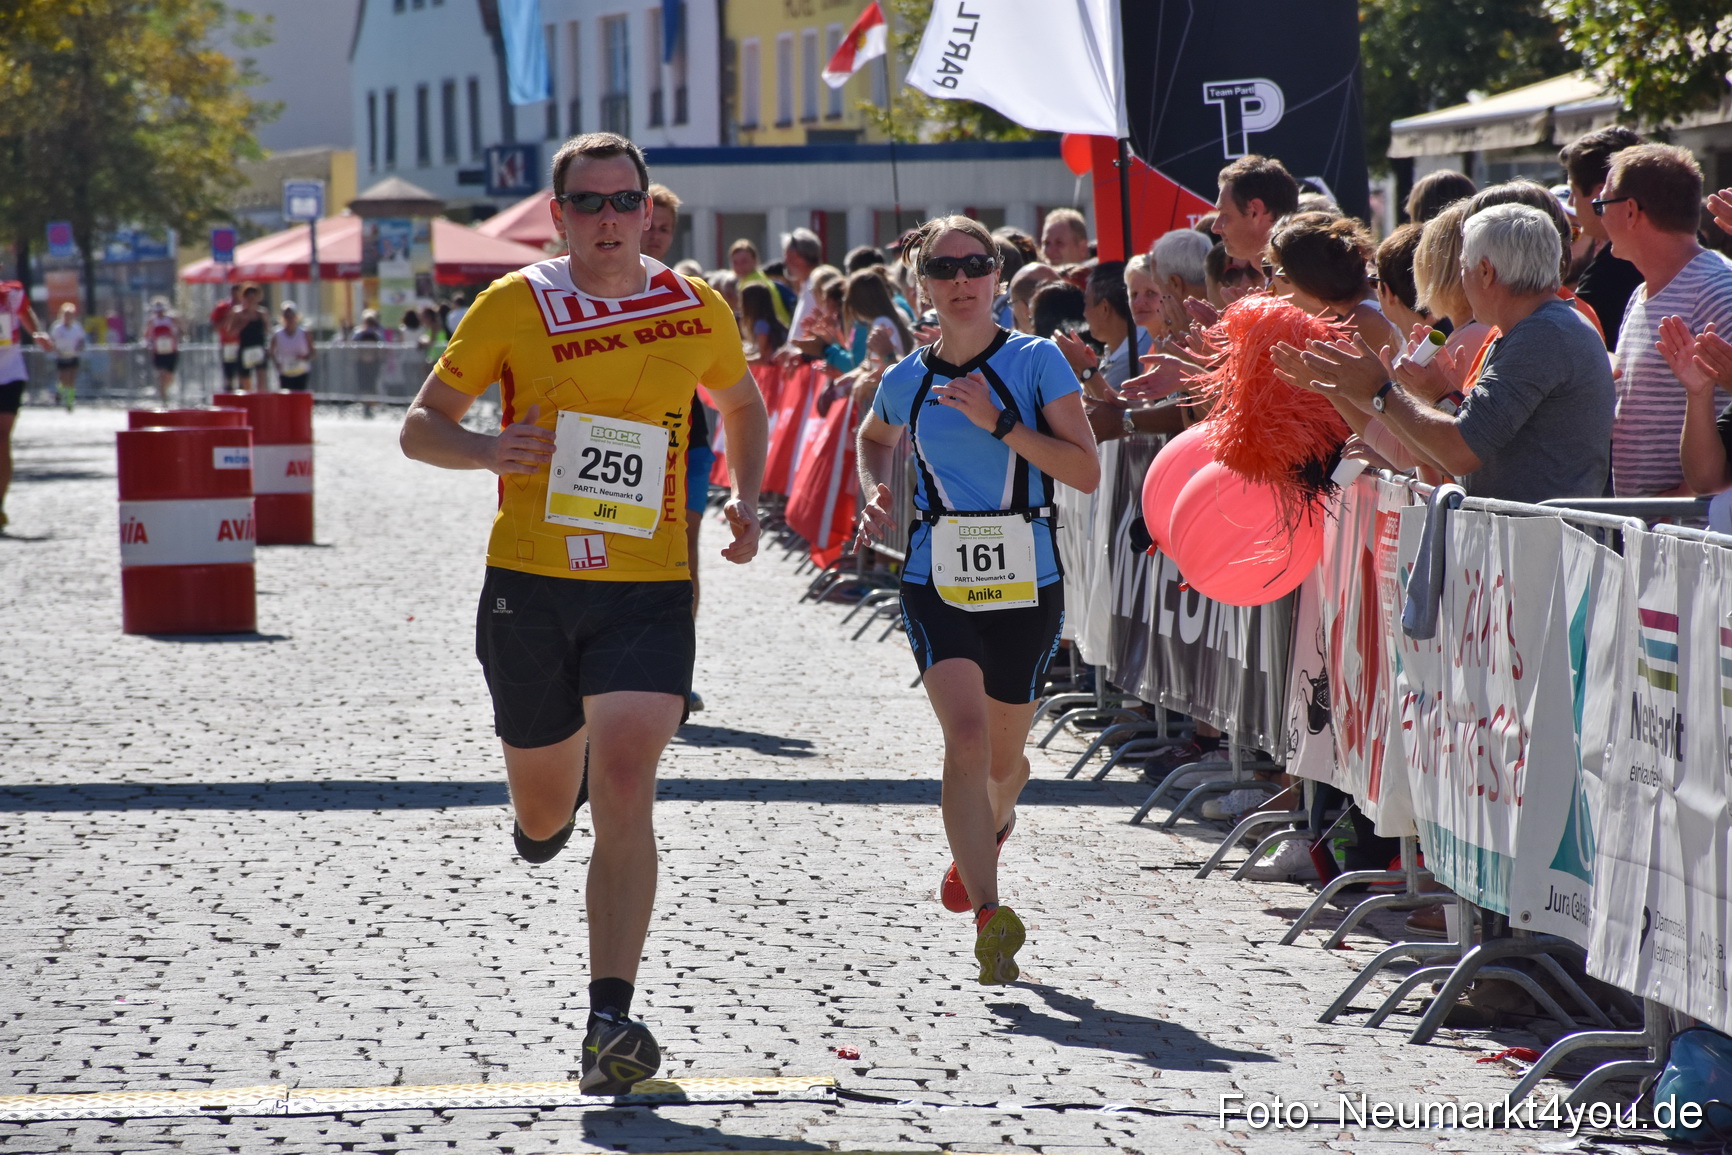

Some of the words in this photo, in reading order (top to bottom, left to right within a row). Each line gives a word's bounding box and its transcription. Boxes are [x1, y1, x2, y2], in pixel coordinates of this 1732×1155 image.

[1209, 87, 1233, 97] Team
[551, 334, 628, 364] MAX
[633, 318, 712, 345] BÖGL
[591, 425, 641, 445] BOCK
[578, 446, 643, 488] 259
[573, 484, 598, 495] PARTL
[599, 488, 633, 500] Neumarkt
[594, 503, 617, 519] Jiri
[959, 525, 1004, 536] BOCK
[956, 543, 1006, 572] 161
[975, 574, 1006, 582] Neumarkt
[967, 588, 1002, 602] Anika
[1545, 884, 1571, 917] Jura
